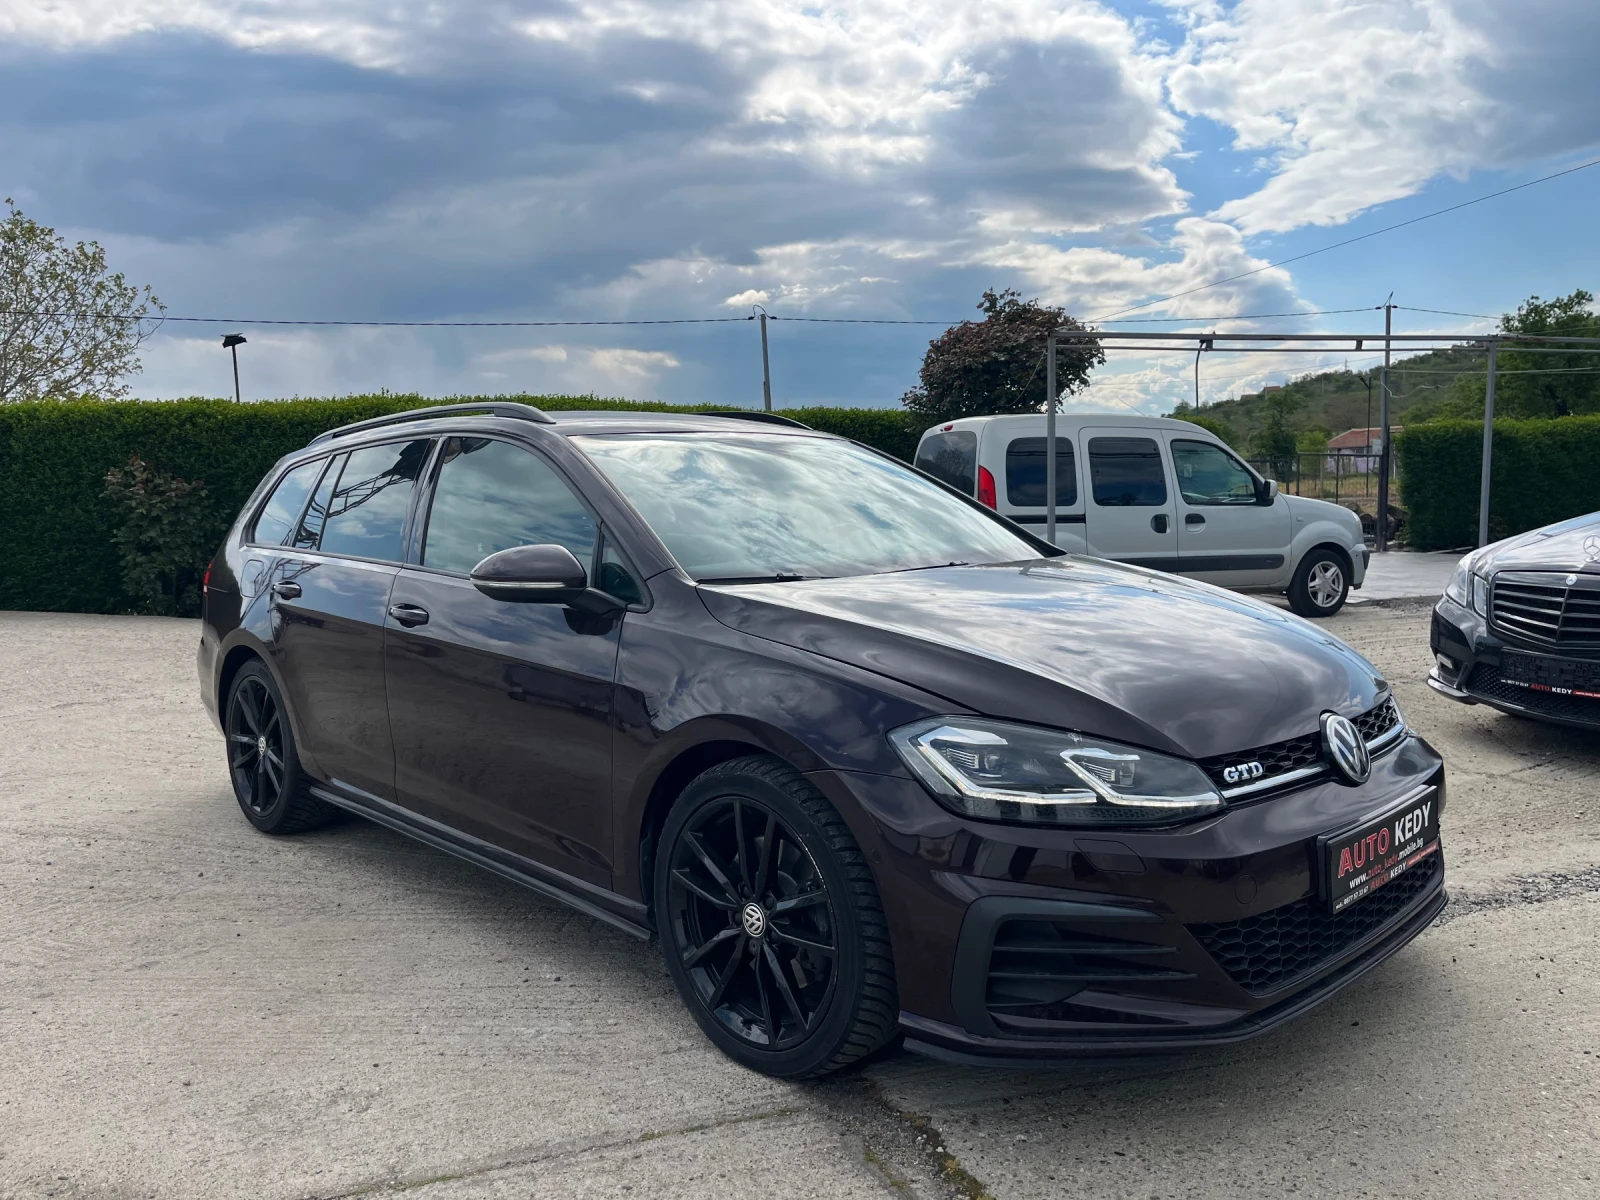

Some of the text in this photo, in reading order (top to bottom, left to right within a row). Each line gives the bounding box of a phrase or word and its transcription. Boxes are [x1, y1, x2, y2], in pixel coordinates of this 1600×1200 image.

[1530, 683, 1550, 692] AUTO
[1551, 686, 1572, 695] KEDY
[1223, 761, 1264, 784] GTD
[1338, 827, 1389, 878] AUTO
[1395, 801, 1431, 846] KEDY
[1370, 873, 1389, 890] AUTO
[1390, 861, 1407, 878] KEDY
